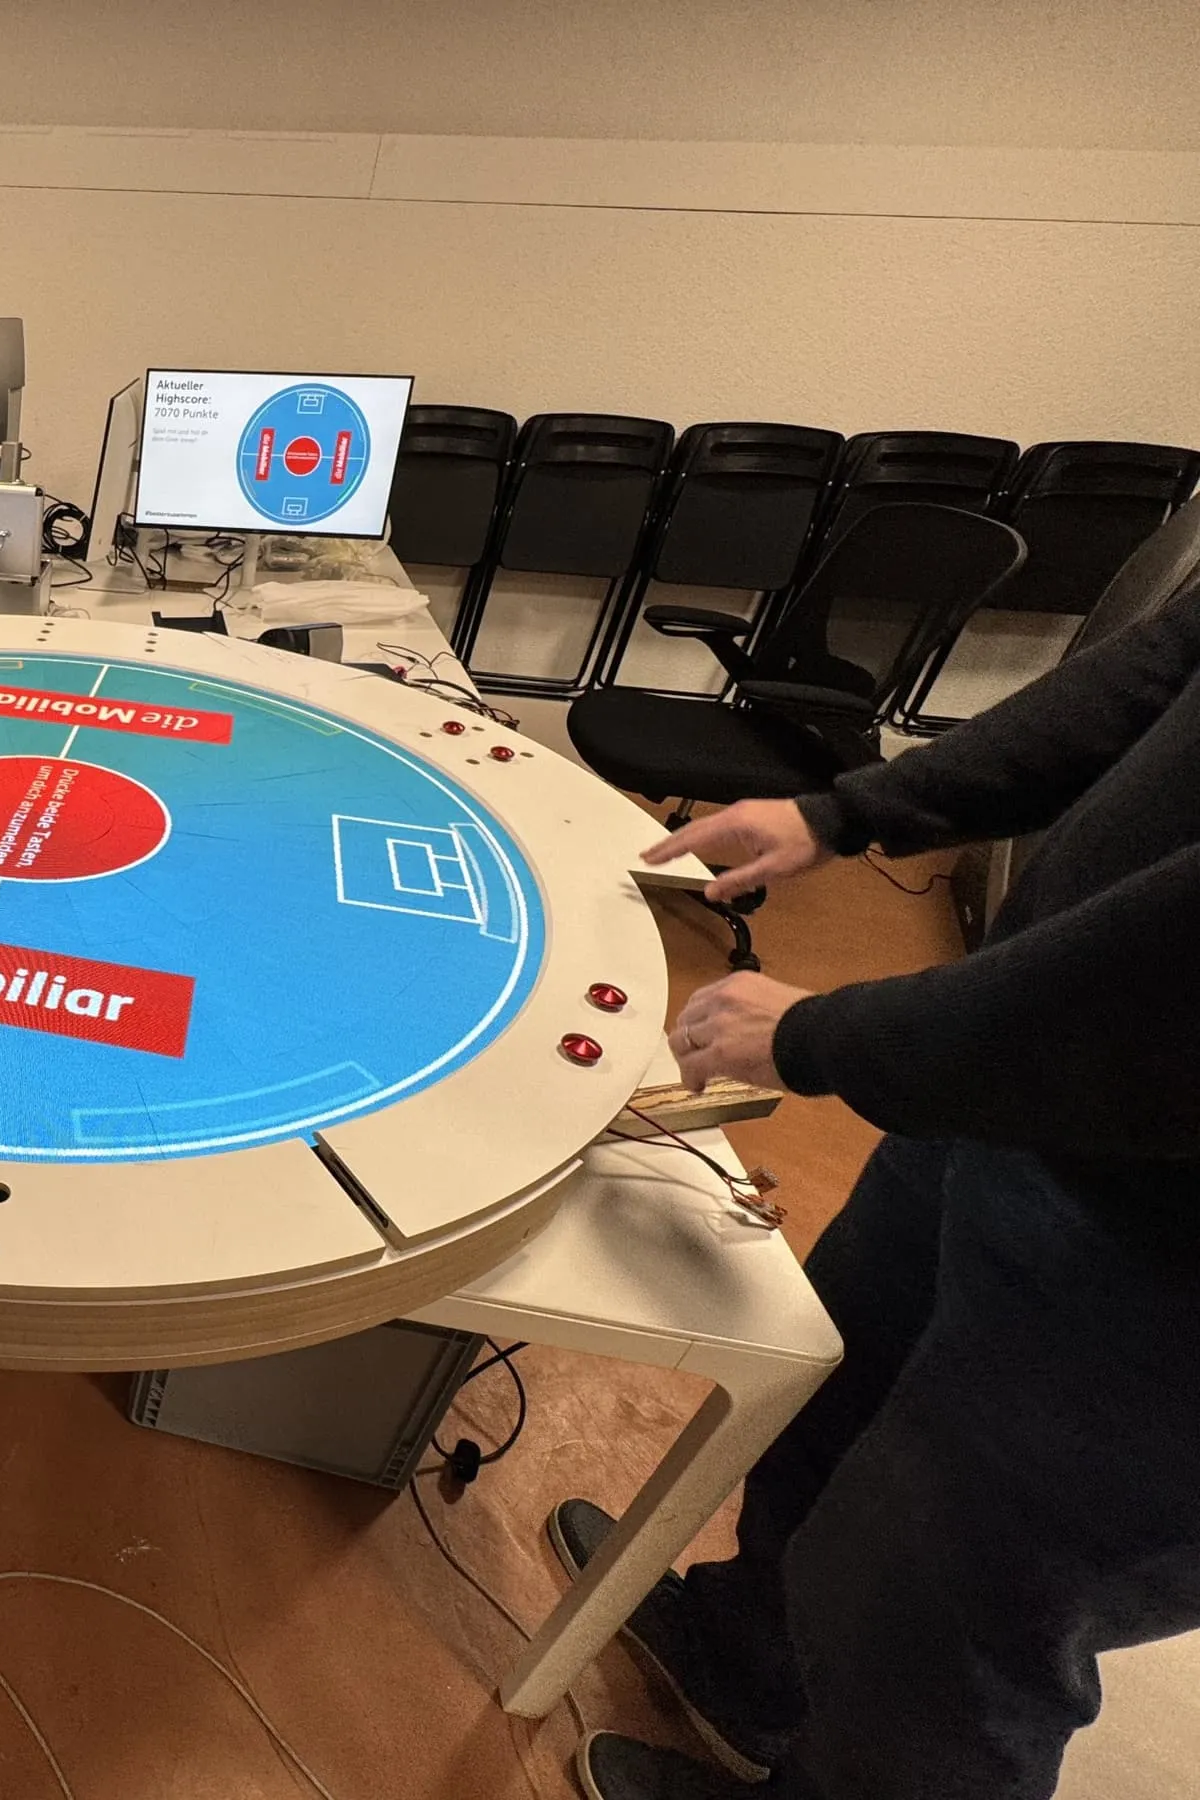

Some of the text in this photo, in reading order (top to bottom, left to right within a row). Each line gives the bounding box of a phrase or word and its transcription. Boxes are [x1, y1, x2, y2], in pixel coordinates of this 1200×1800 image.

[156, 379, 204, 391] Aktueller
[155, 393, 212, 406] Highscore:
[154, 407, 219, 420] 7070 Punkte
[141, 711, 200, 732] die
[34, 765, 54, 781] um
[23, 780, 48, 801] dich
[52, 768, 80, 800] Drücke
[36, 800, 66, 829] beide
